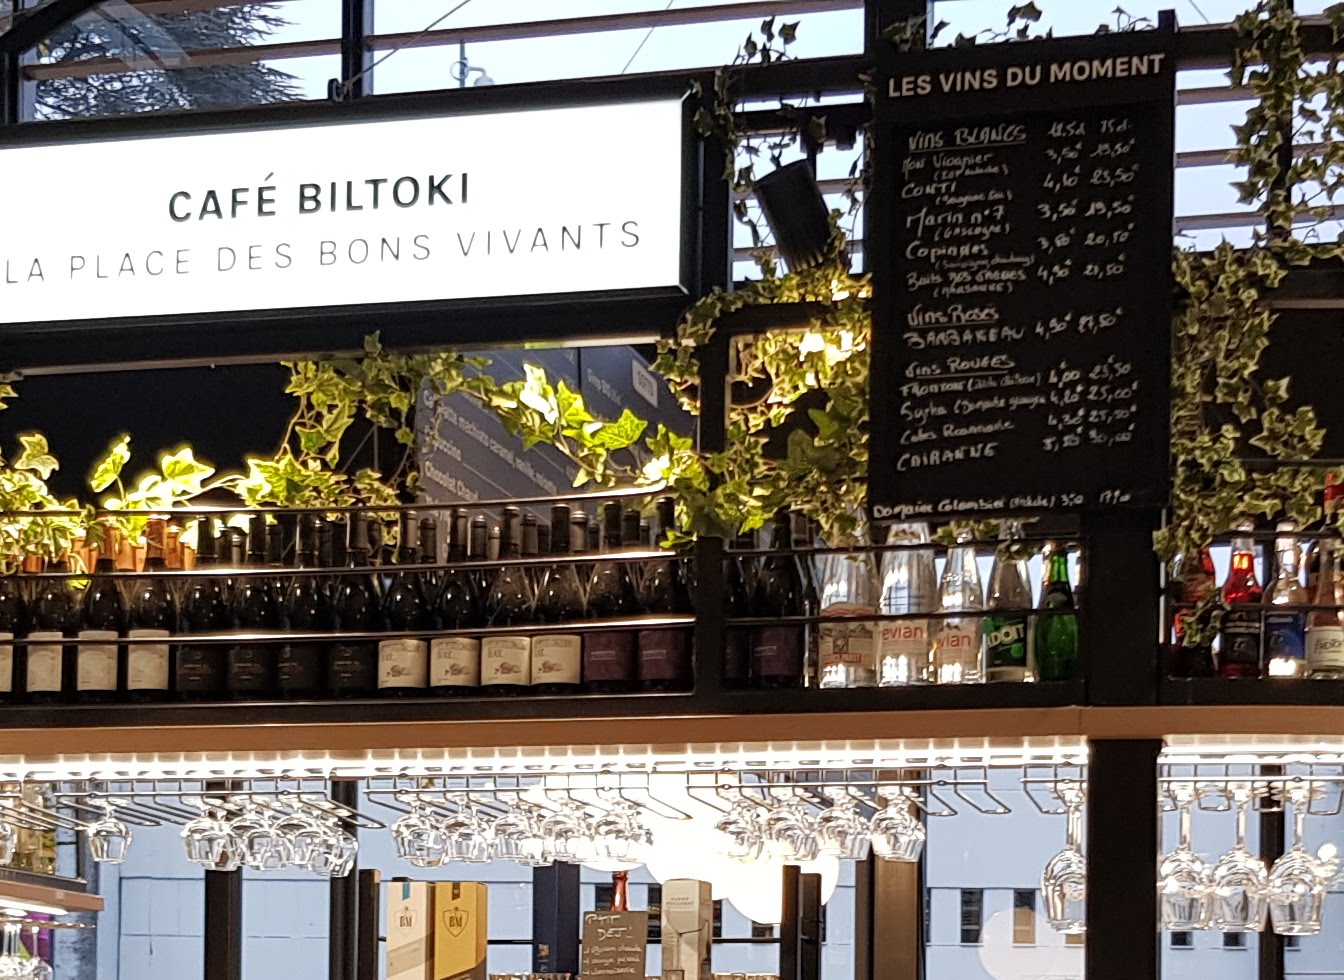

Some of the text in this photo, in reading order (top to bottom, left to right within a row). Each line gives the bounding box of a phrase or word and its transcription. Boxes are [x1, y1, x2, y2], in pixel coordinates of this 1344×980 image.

[888, 53, 1166, 98] LES VINS DU MOMENT
[169, 173, 470, 223] CAFÉ BILTOKI
[5, 220, 641, 284] LA PLACE DES BONS VIVANTS
[883, 624, 924, 641] evian
[936, 632, 972, 648] vian
[987, 622, 1025, 648] DOIT
